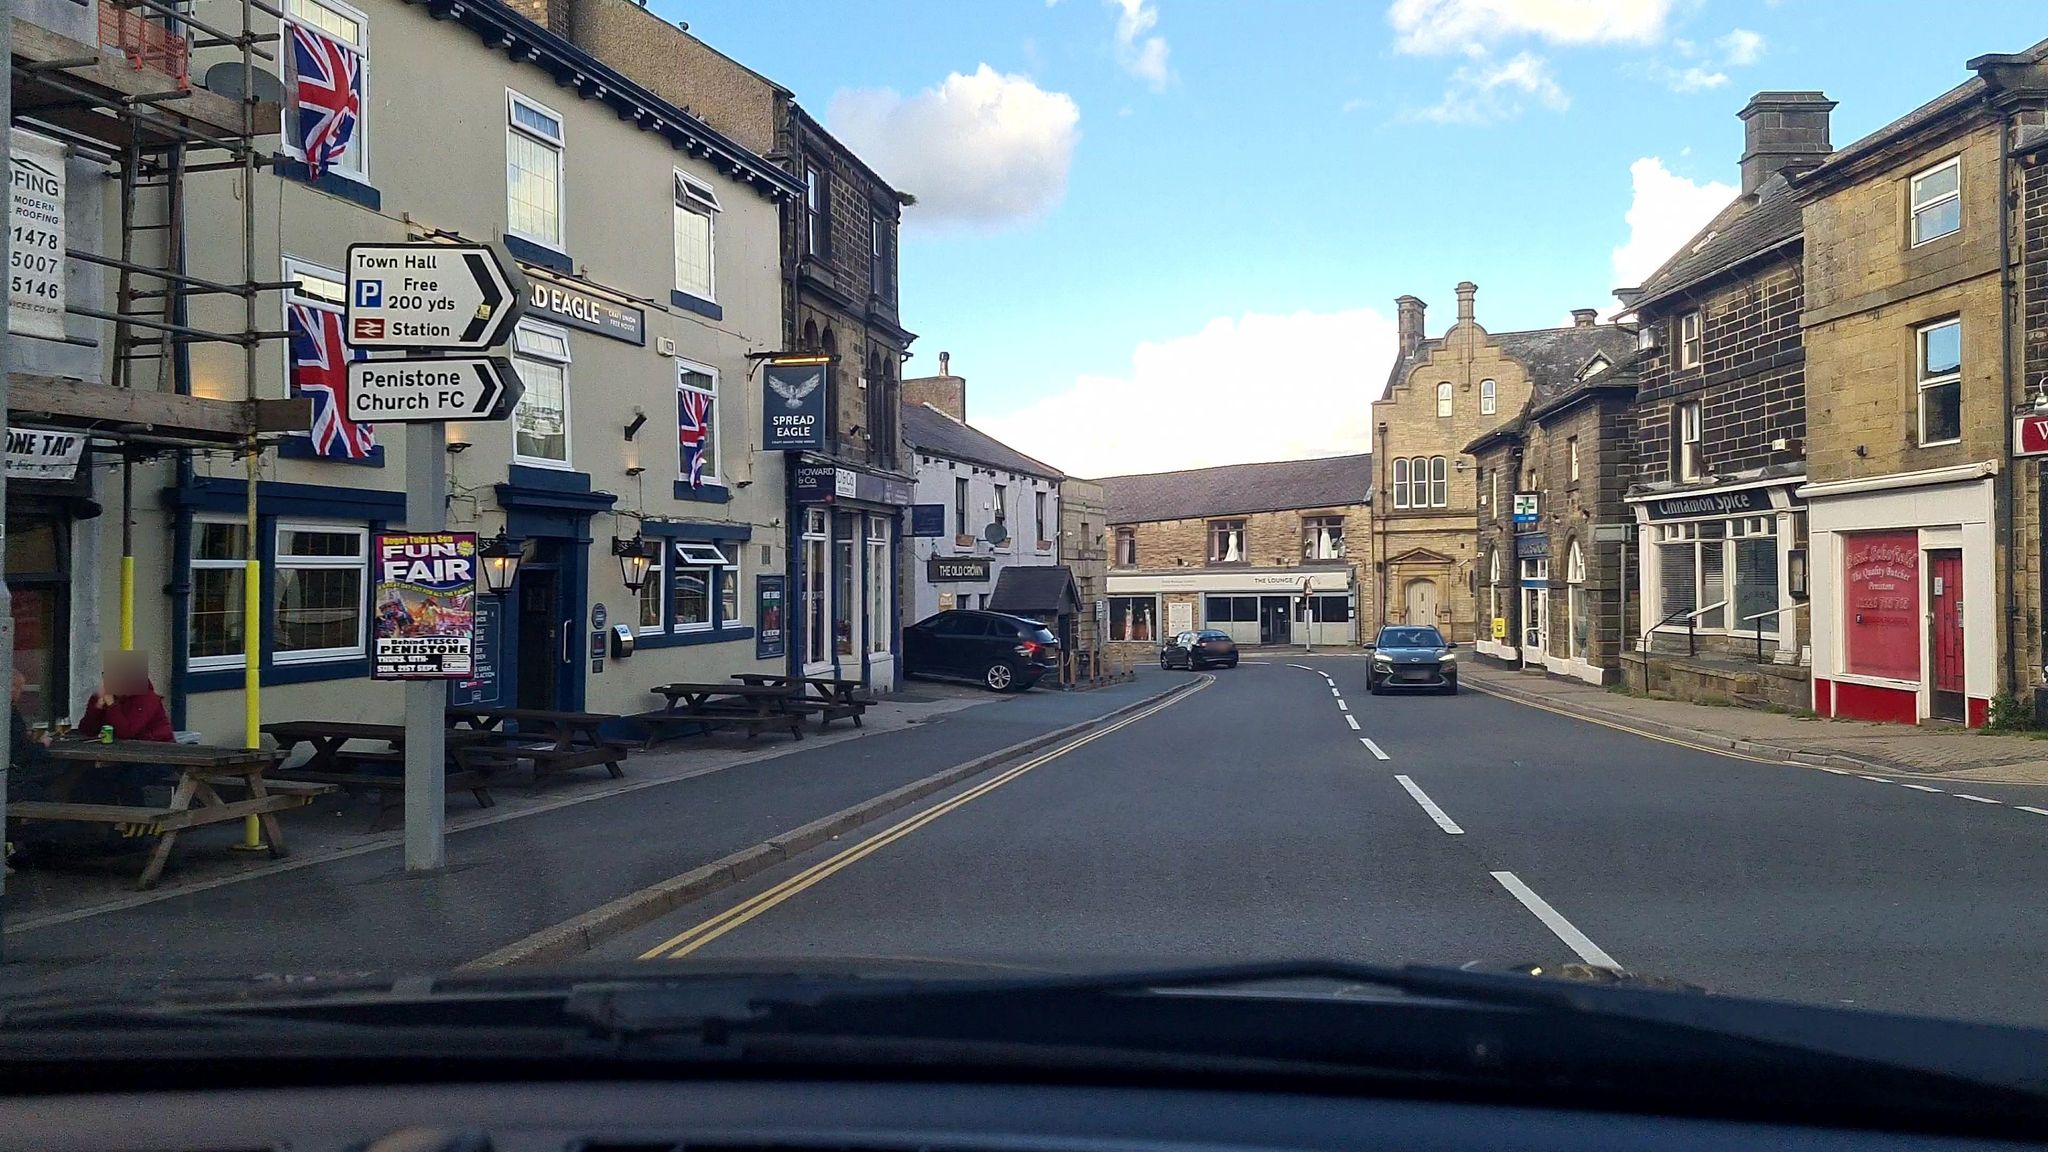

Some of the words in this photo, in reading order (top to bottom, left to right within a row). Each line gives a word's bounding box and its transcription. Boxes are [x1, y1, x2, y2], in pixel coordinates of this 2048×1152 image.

[10, 169, 59, 197] FING
[14, 195, 55, 212] MODERN
[16, 207, 59, 225] ROOFING
[10, 226, 58, 250] 1478
[11, 251, 58, 274] 5007
[357, 254, 398, 269] Town
[405, 255, 437, 269] Hall
[12, 276, 59, 299] 5146
[404, 278, 438, 292] Free
[363, 281, 380, 306] P
[389, 296, 422, 310] 200
[429, 296, 455, 312] yds
[551, 289, 600, 325] EAGLE
[610, 318, 621, 328] FREE
[621, 321, 635, 333] HOUSE
[622, 313, 636, 324] UNION
[393, 322, 450, 338] Station
[362, 370, 461, 387] Penistone
[356, 391, 429, 411] Church
[438, 391, 465, 409] FC
[773, 415, 815, 426] SPREAD
[776, 426, 811, 437] EAGLE
[41, 435, 75, 456] TAP
[798, 467, 834, 477] HOWARD
[1659, 496, 1716, 515] Cinnamon
[1717, 491, 1751, 514] Spice
[438, 535, 453, 543] Son
[382, 543, 457, 559] FUN
[383, 559, 472, 583] FAIR
[939, 565, 951, 576] THE
[951, 565, 963, 576] OLD
[964, 563, 984, 576] CROWN
[1863, 565, 1884, 579] Quality
[1886, 566, 1911, 581] Butcher
[380, 645, 469, 654] PENISTONE
